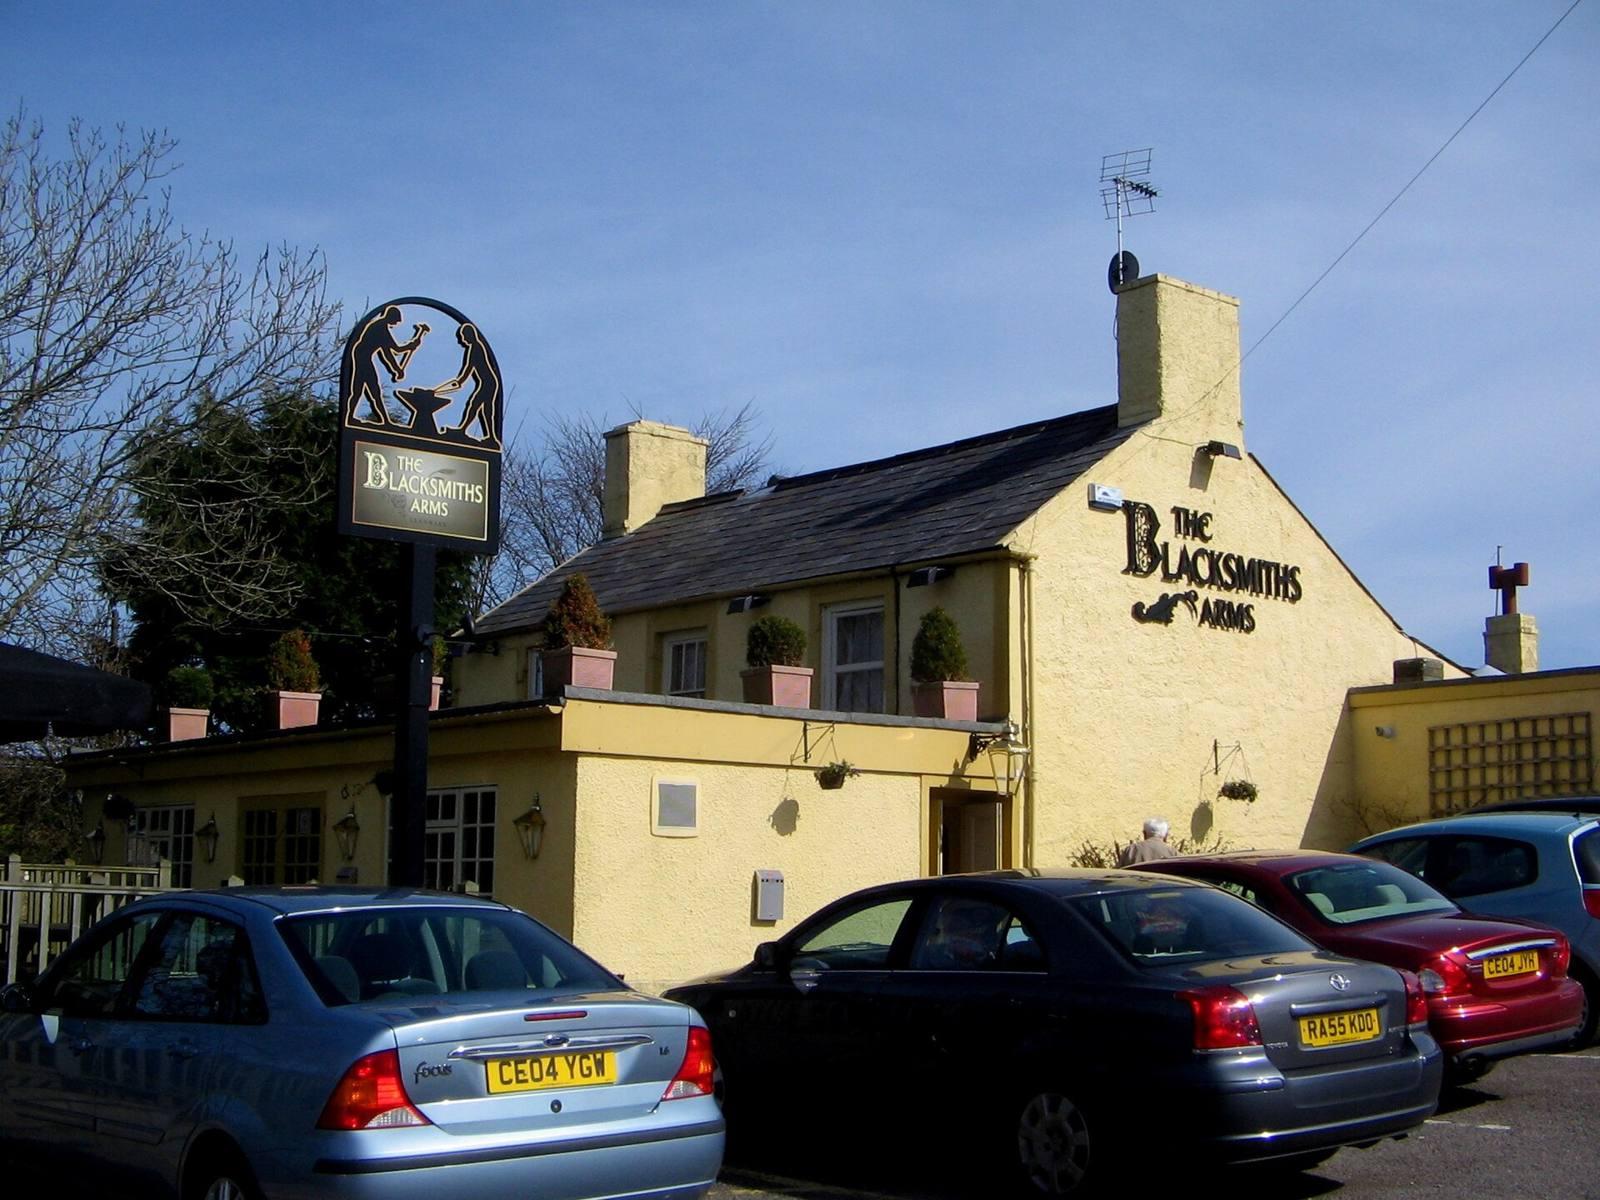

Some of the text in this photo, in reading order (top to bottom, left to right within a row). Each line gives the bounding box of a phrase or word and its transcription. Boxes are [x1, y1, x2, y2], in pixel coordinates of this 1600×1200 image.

[362, 451, 483, 504] BLACKSMITHS
[397, 455, 423, 473] THE
[411, 499, 448, 516] ARMS
[1170, 506, 1213, 543] THE
[1120, 499, 1302, 604] BLACKSMITHS
[1198, 596, 1256, 634] ARMS
[1488, 958, 1515, 975] CE04
[1307, 1013, 1374, 1040] RA55 KDO
[499, 1053, 606, 1085] CE04 YGW
